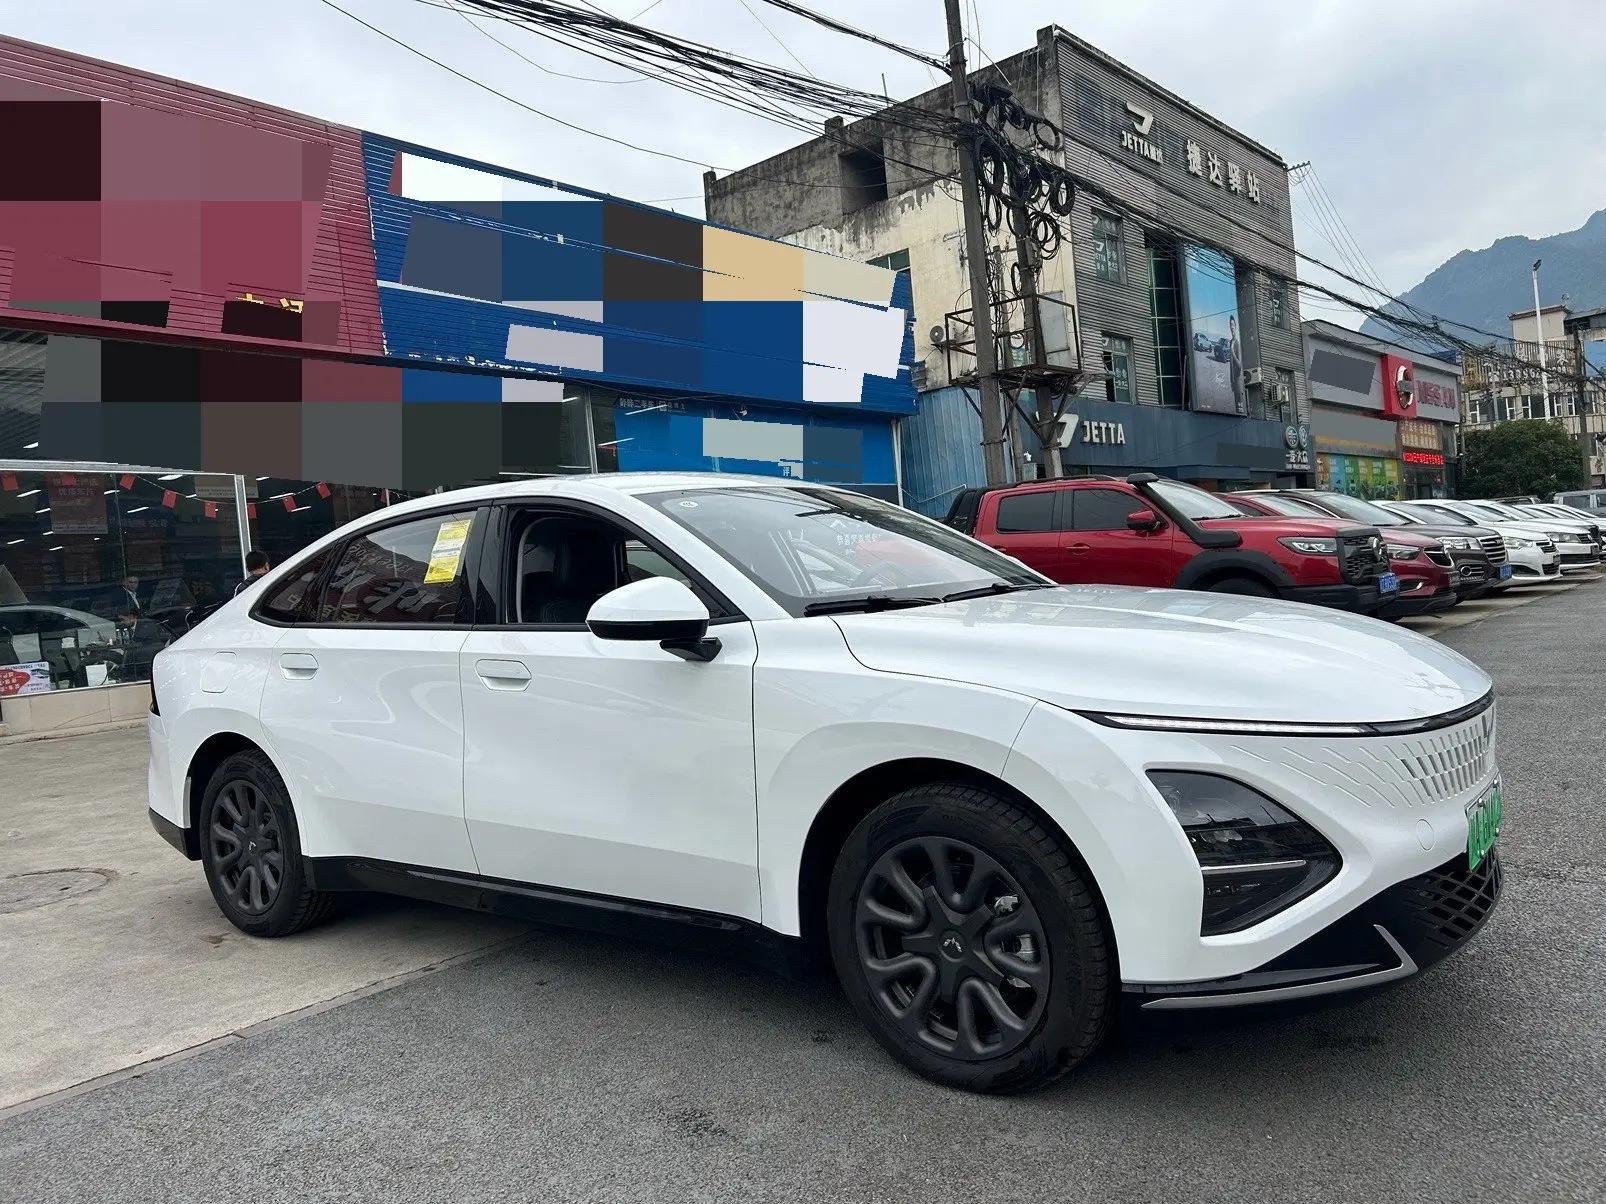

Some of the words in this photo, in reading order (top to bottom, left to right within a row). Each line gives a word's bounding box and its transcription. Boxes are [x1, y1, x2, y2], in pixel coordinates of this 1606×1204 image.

[1121, 130, 1149, 158] JETTA
[1186, 139, 1261, 204] 捷达驿站
[1081, 420, 1126, 445] JETTA
